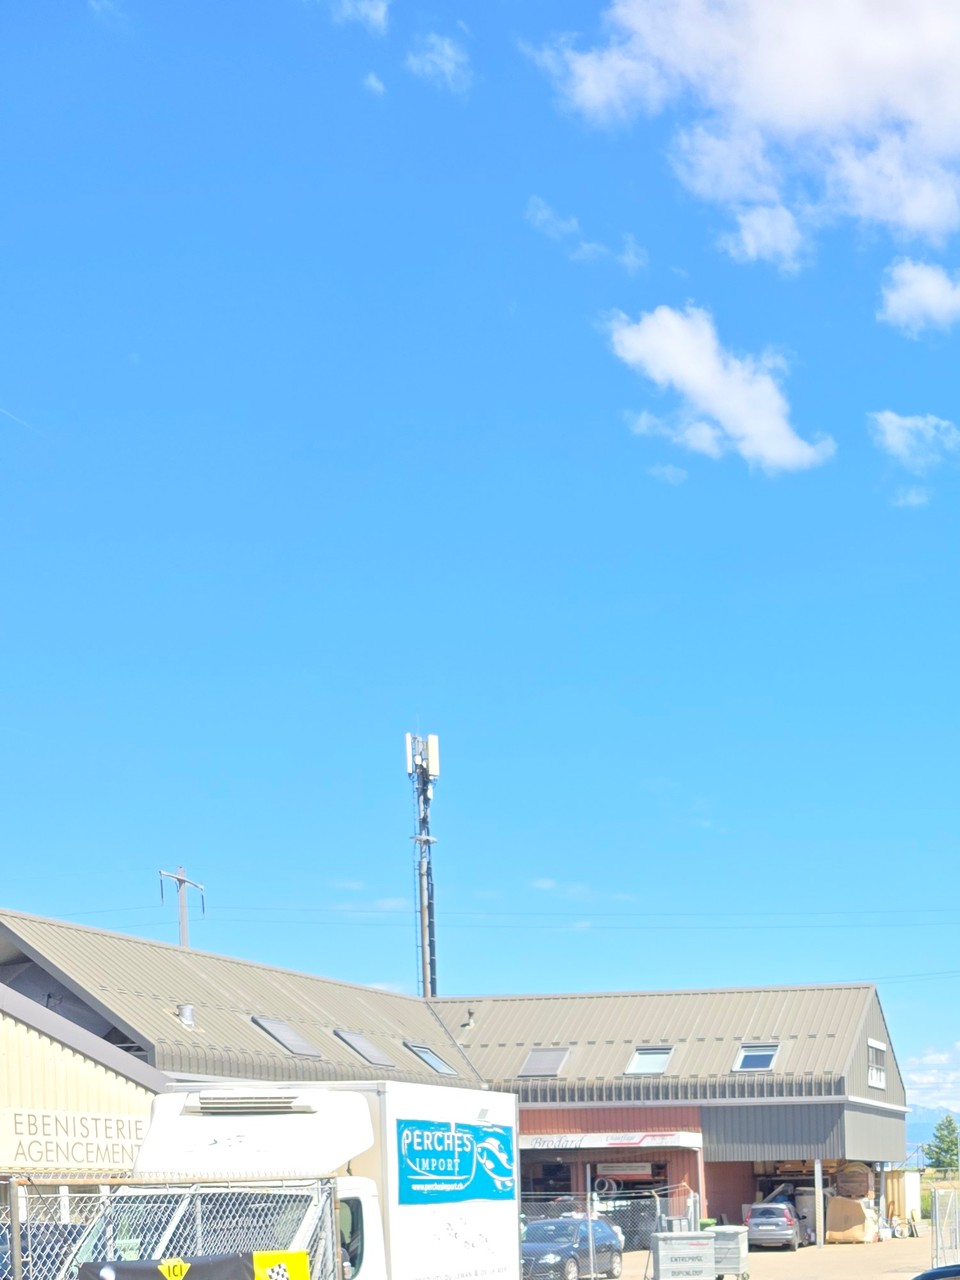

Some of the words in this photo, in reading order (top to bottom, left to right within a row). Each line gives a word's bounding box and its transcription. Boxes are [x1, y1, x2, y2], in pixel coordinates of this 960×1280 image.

[14, 1113, 143, 1140] EBENISTERIE
[403, 1130, 472, 1152] PERCHES
[415, 1157, 461, 1172] IMPORT
